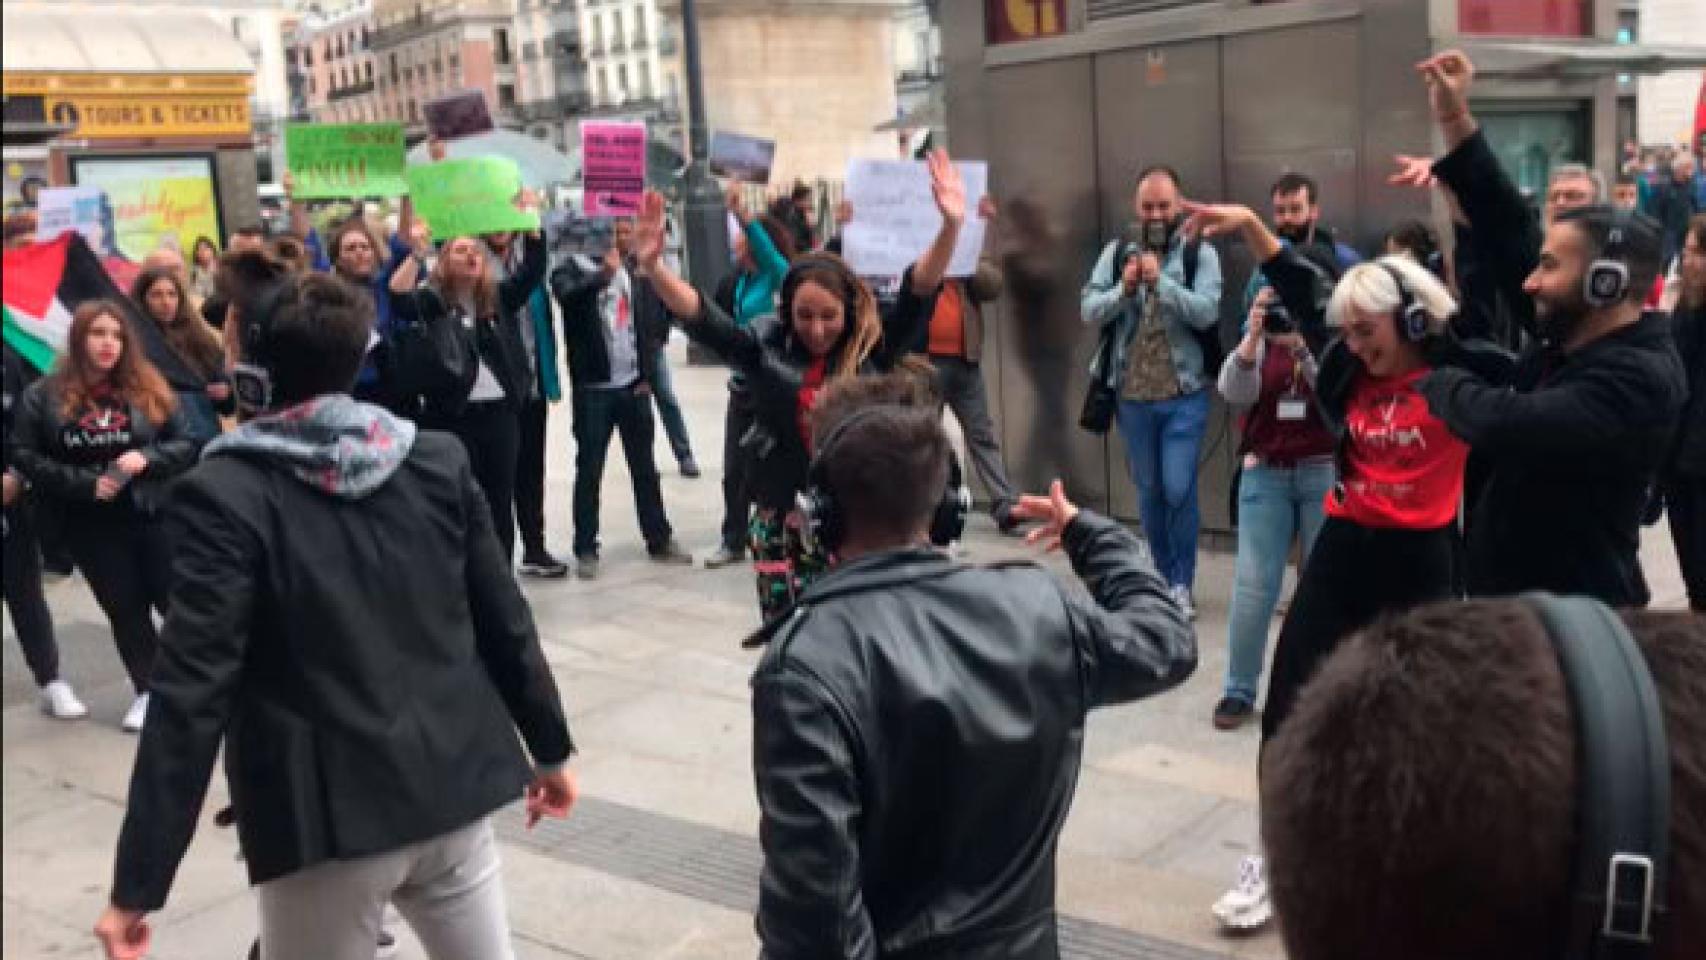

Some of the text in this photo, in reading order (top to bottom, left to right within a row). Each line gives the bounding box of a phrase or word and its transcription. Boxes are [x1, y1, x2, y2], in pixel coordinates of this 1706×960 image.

[84, 104, 245, 125] TOURS & TICKETS
